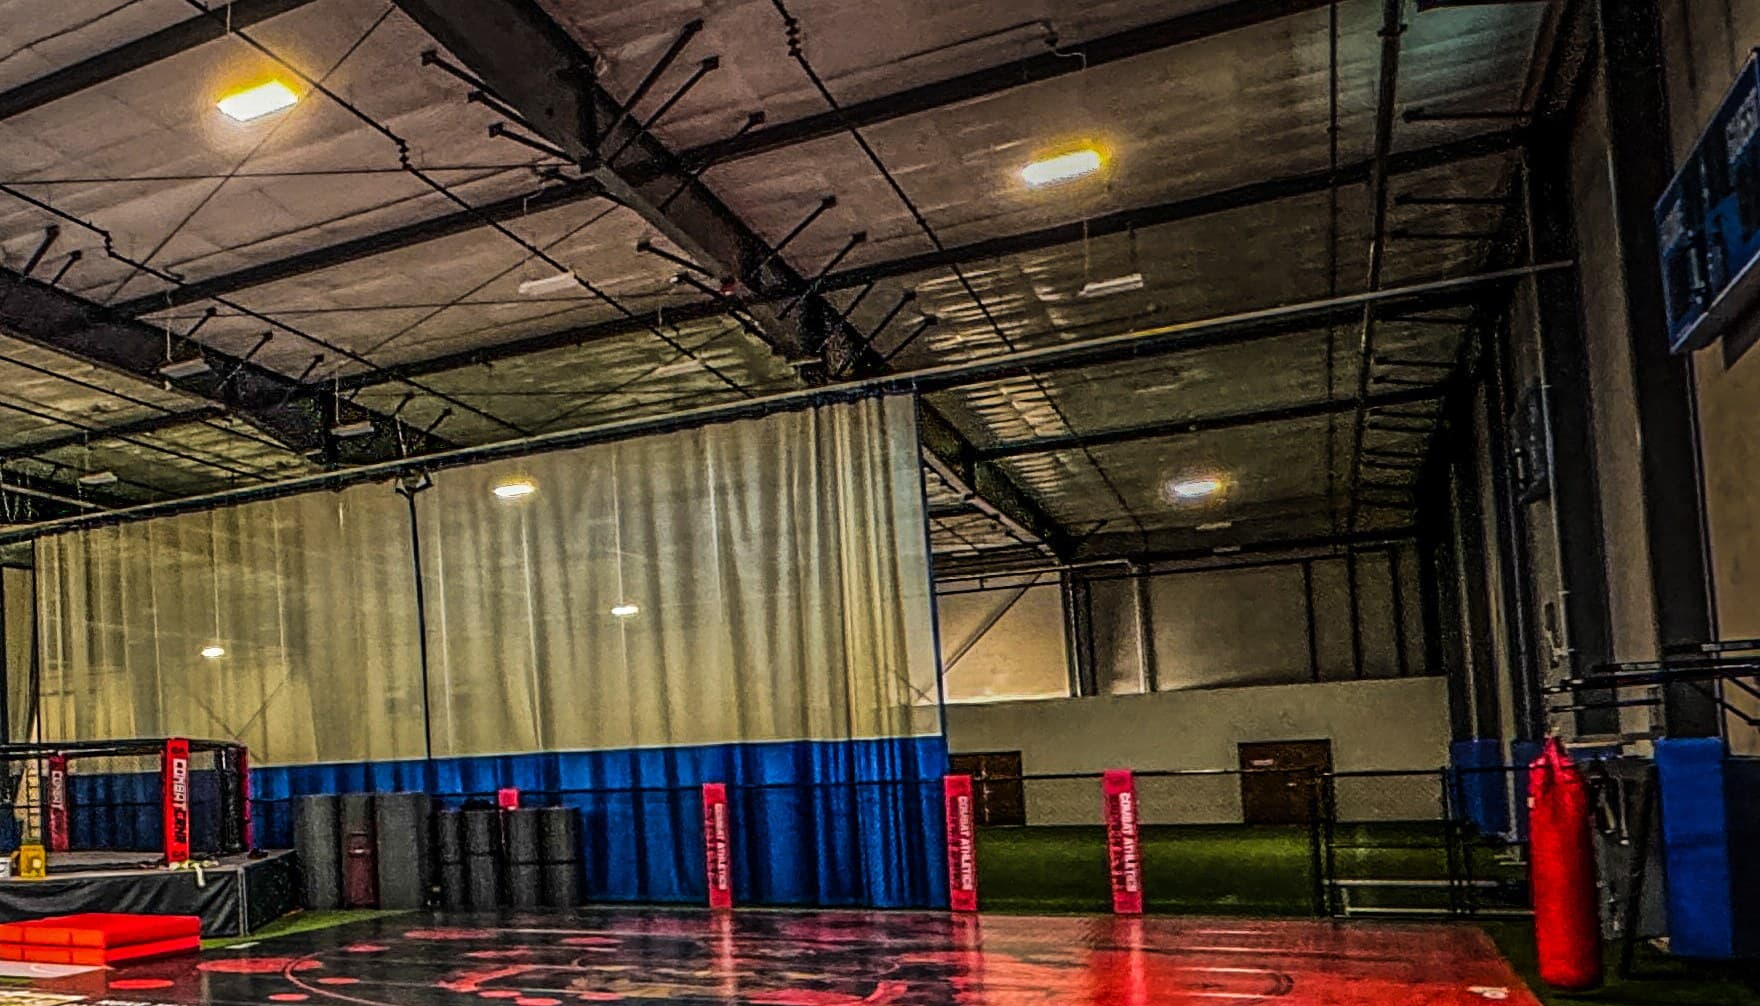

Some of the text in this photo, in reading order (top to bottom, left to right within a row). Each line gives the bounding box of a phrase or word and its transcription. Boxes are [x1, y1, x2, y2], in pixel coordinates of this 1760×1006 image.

[173, 758, 188, 812] COMBAT
[714, 803, 726, 840] COMBAT
[958, 795, 973, 890] COMBAT ATHLETICS
[1119, 792, 1138, 892] COMBAT ATHLETICS
